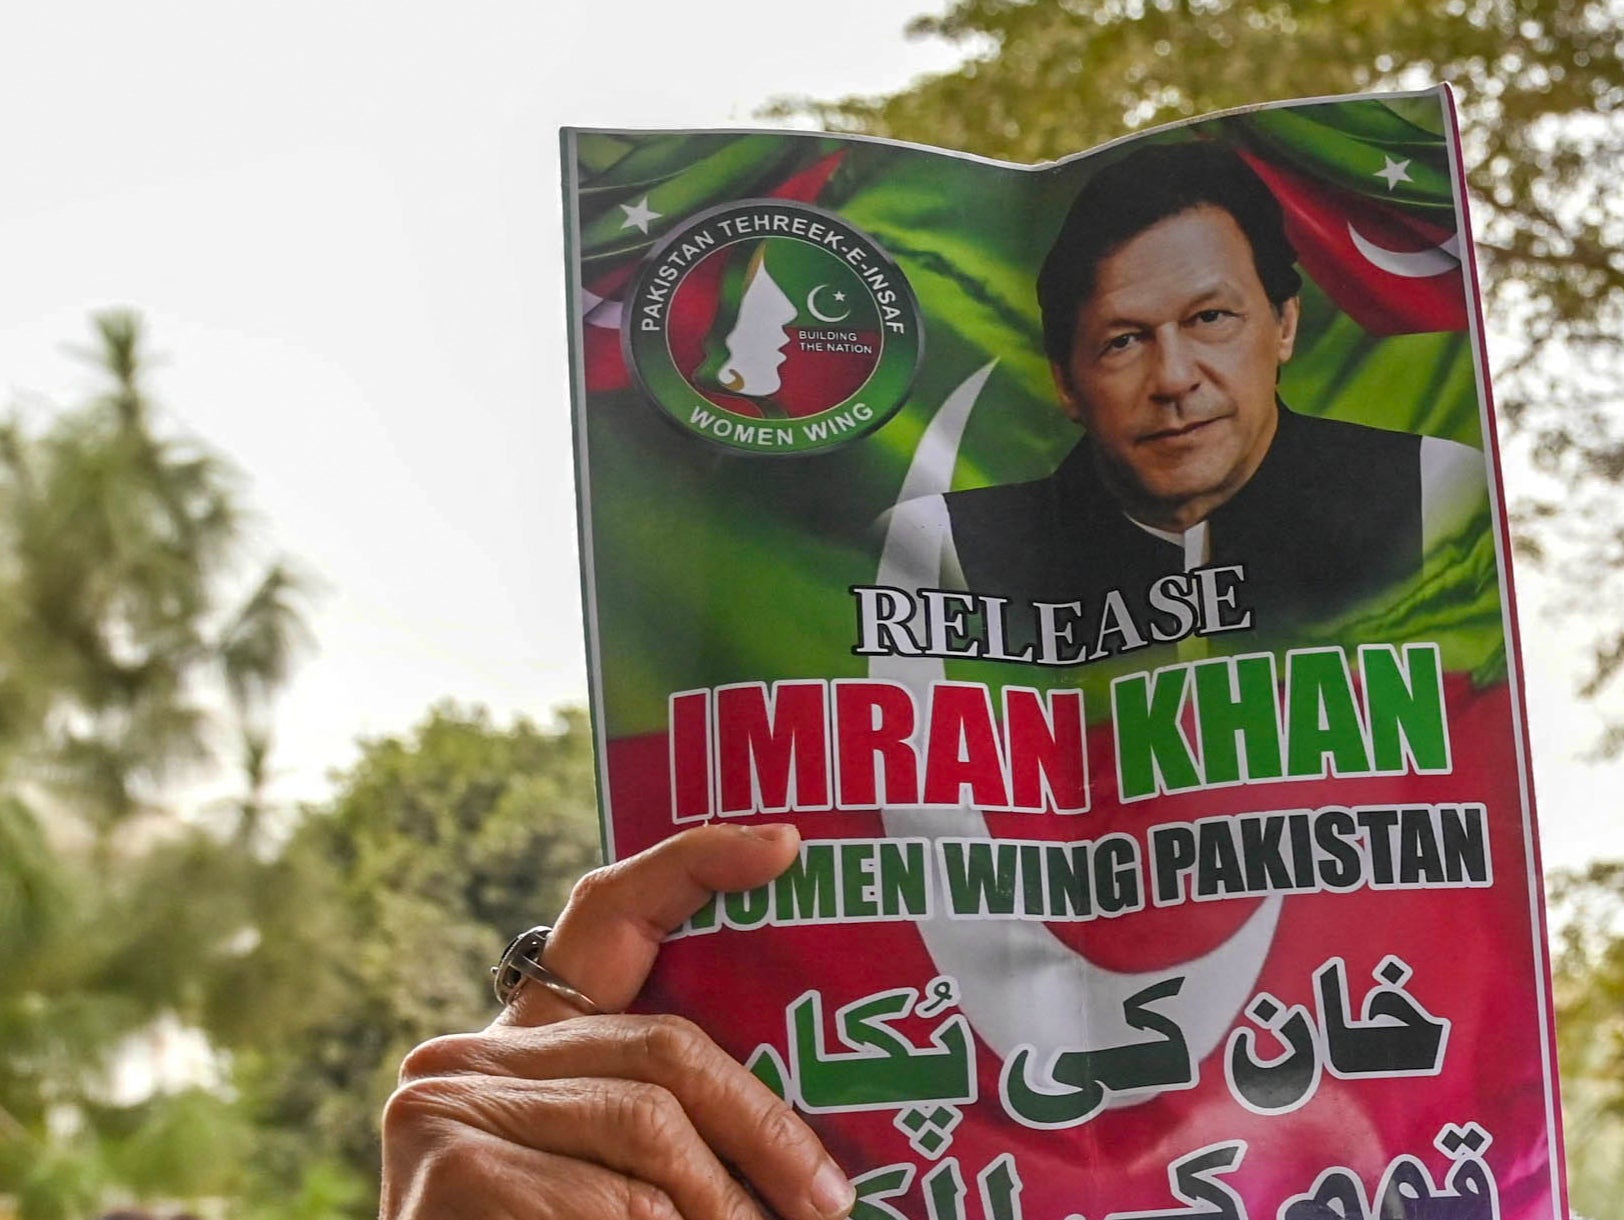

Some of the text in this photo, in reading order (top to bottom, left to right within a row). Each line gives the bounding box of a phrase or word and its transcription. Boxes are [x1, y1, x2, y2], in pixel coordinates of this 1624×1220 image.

[641, 214, 905, 335] PAKISTAN TEHREEK-E-INSAF
[798, 330, 858, 342] BUILDING
[800, 342, 873, 354] THE NATION
[689, 402, 875, 446] WOMEN WING
[851, 562, 1255, 670] RELEASE
[667, 643, 1453, 822] IMRAN KHAN
[935, 832, 1143, 921] WING
[1150, 803, 1490, 905] PAKISTAN
[1224, 954, 1451, 1116] خان
